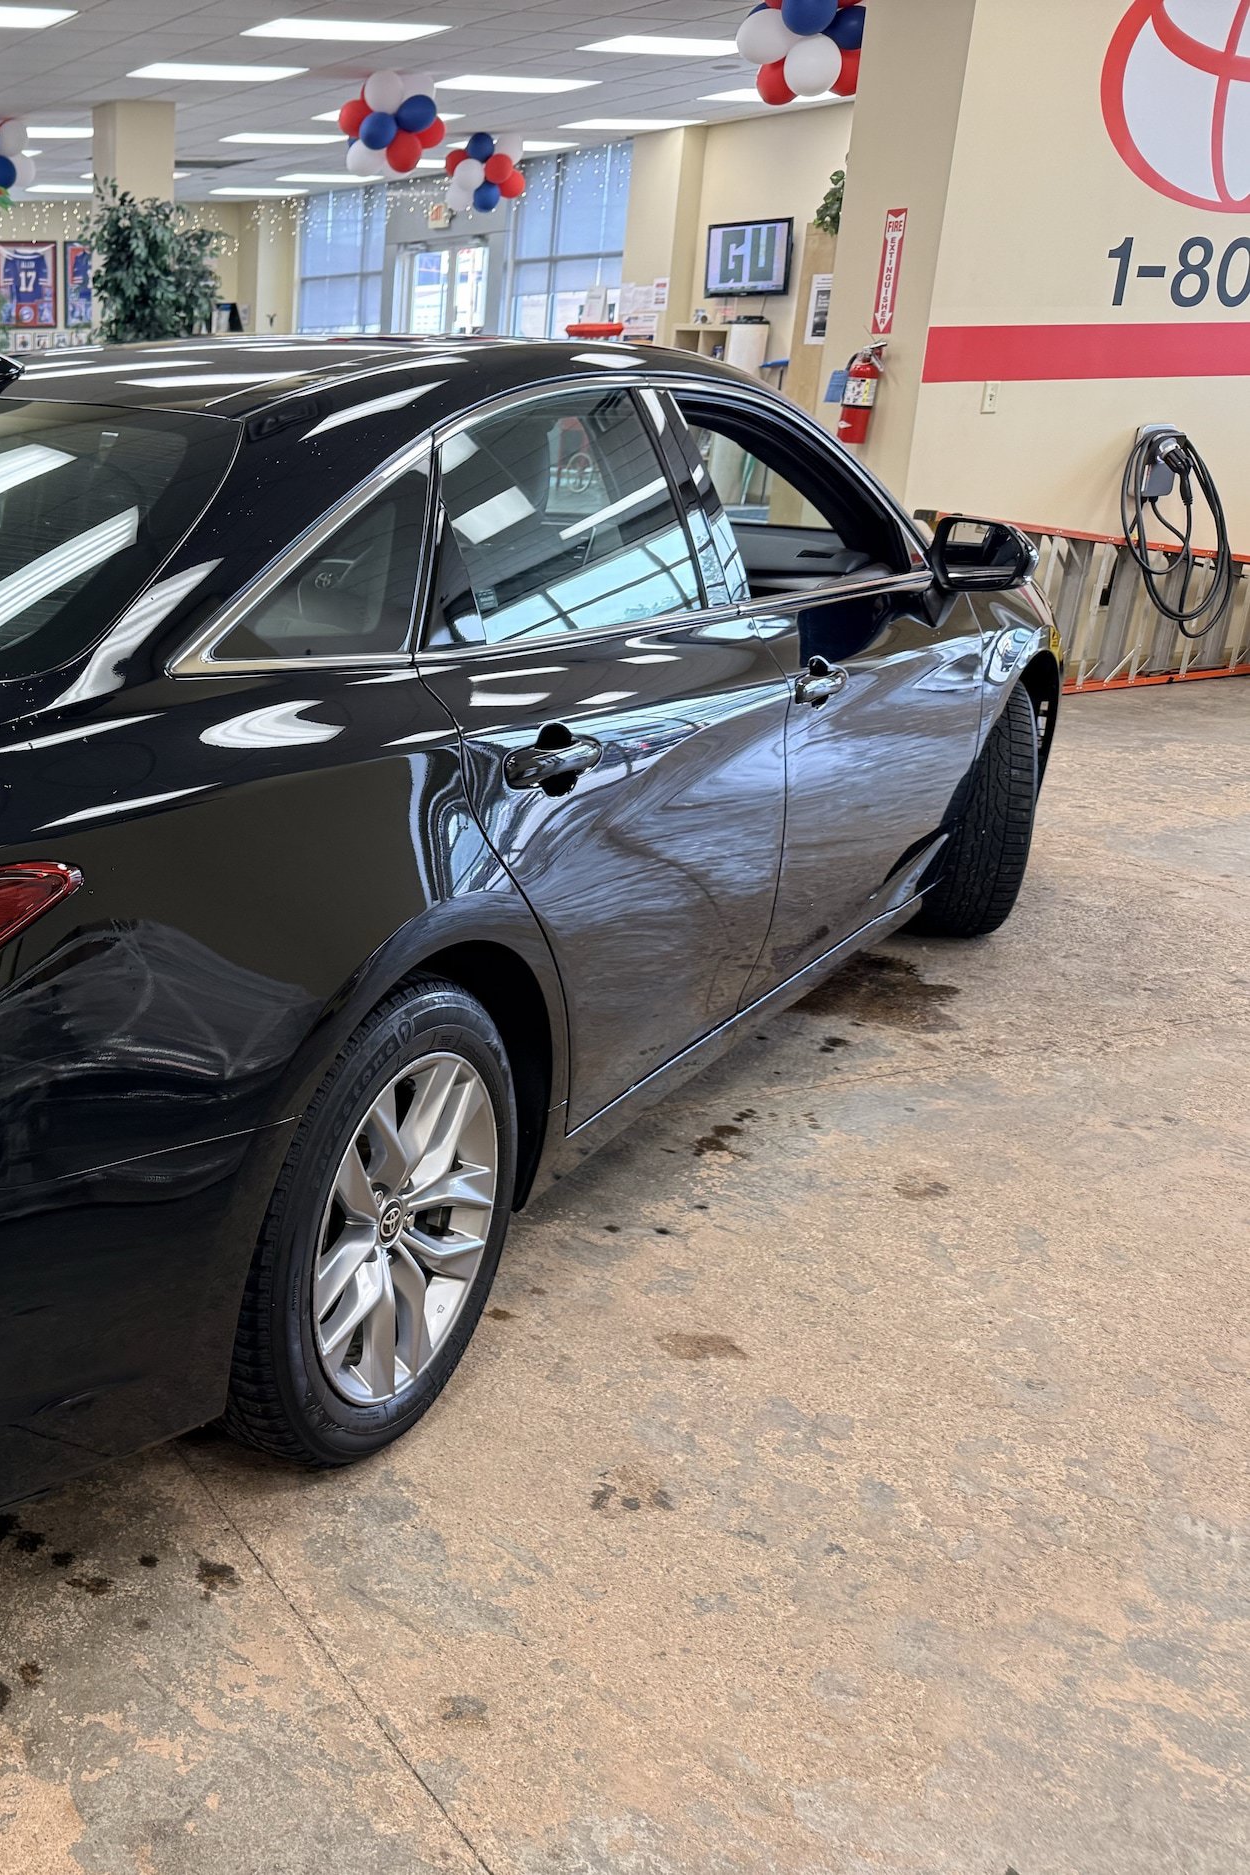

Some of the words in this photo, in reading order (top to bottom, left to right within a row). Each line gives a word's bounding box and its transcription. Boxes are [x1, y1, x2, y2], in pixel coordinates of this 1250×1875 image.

[887, 219, 904, 233] FIRE
[718, 225, 777, 284] GU
[19, 271, 37, 292] 17
[878, 236, 897, 325] EXTINGUISHER
